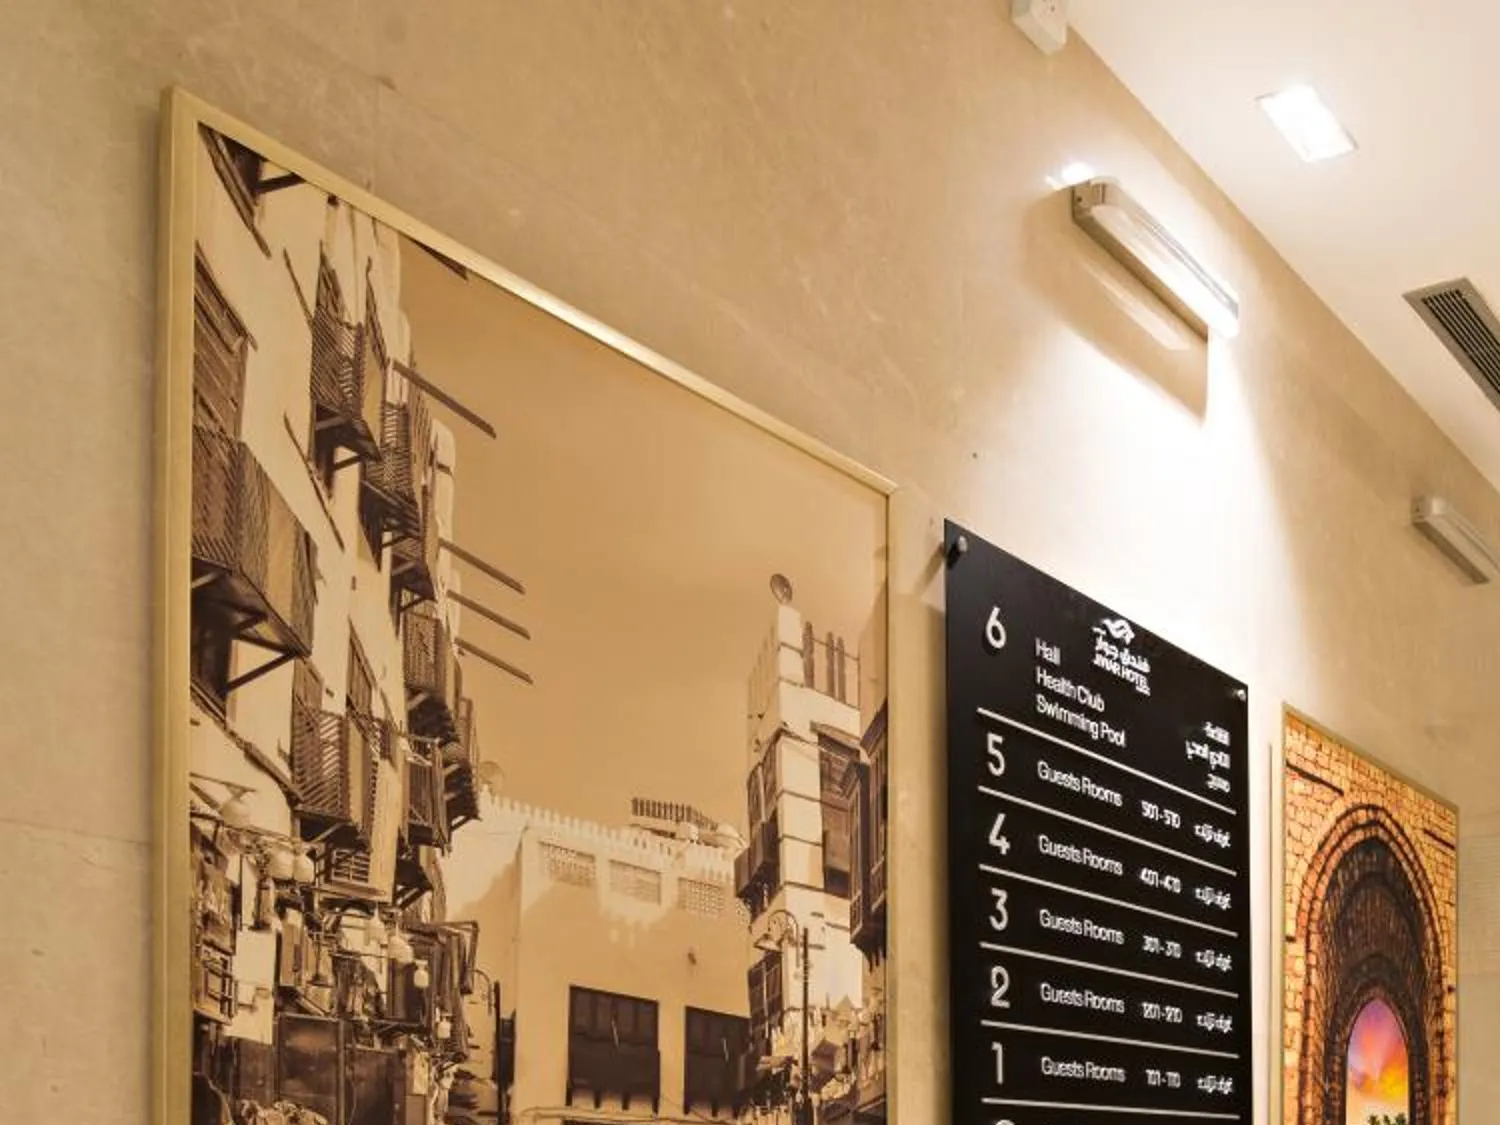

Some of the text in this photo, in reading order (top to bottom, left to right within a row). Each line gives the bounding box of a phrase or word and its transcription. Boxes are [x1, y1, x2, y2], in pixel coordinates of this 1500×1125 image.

[986, 606, 1006, 648] 6
[1036, 638, 1060, 665] Hall
[1036, 666, 1104, 712] Health Club
[1036, 694, 1125, 747] Swimming Pool
[987, 733, 1005, 776] 5
[1038, 760, 1122, 806] Guests Rooms
[989, 813, 1010, 855] 4
[1038, 835, 1123, 875] Guests Rooms
[990, 888, 1008, 930] 3
[1040, 909, 1124, 944] Guests Rooms
[991, 966, 1009, 1008] 2
[1041, 983, 1124, 1013] Guests Rooms
[992, 1042, 1003, 1083] 1
[1042, 1056, 1125, 1082] Guests Rooms
